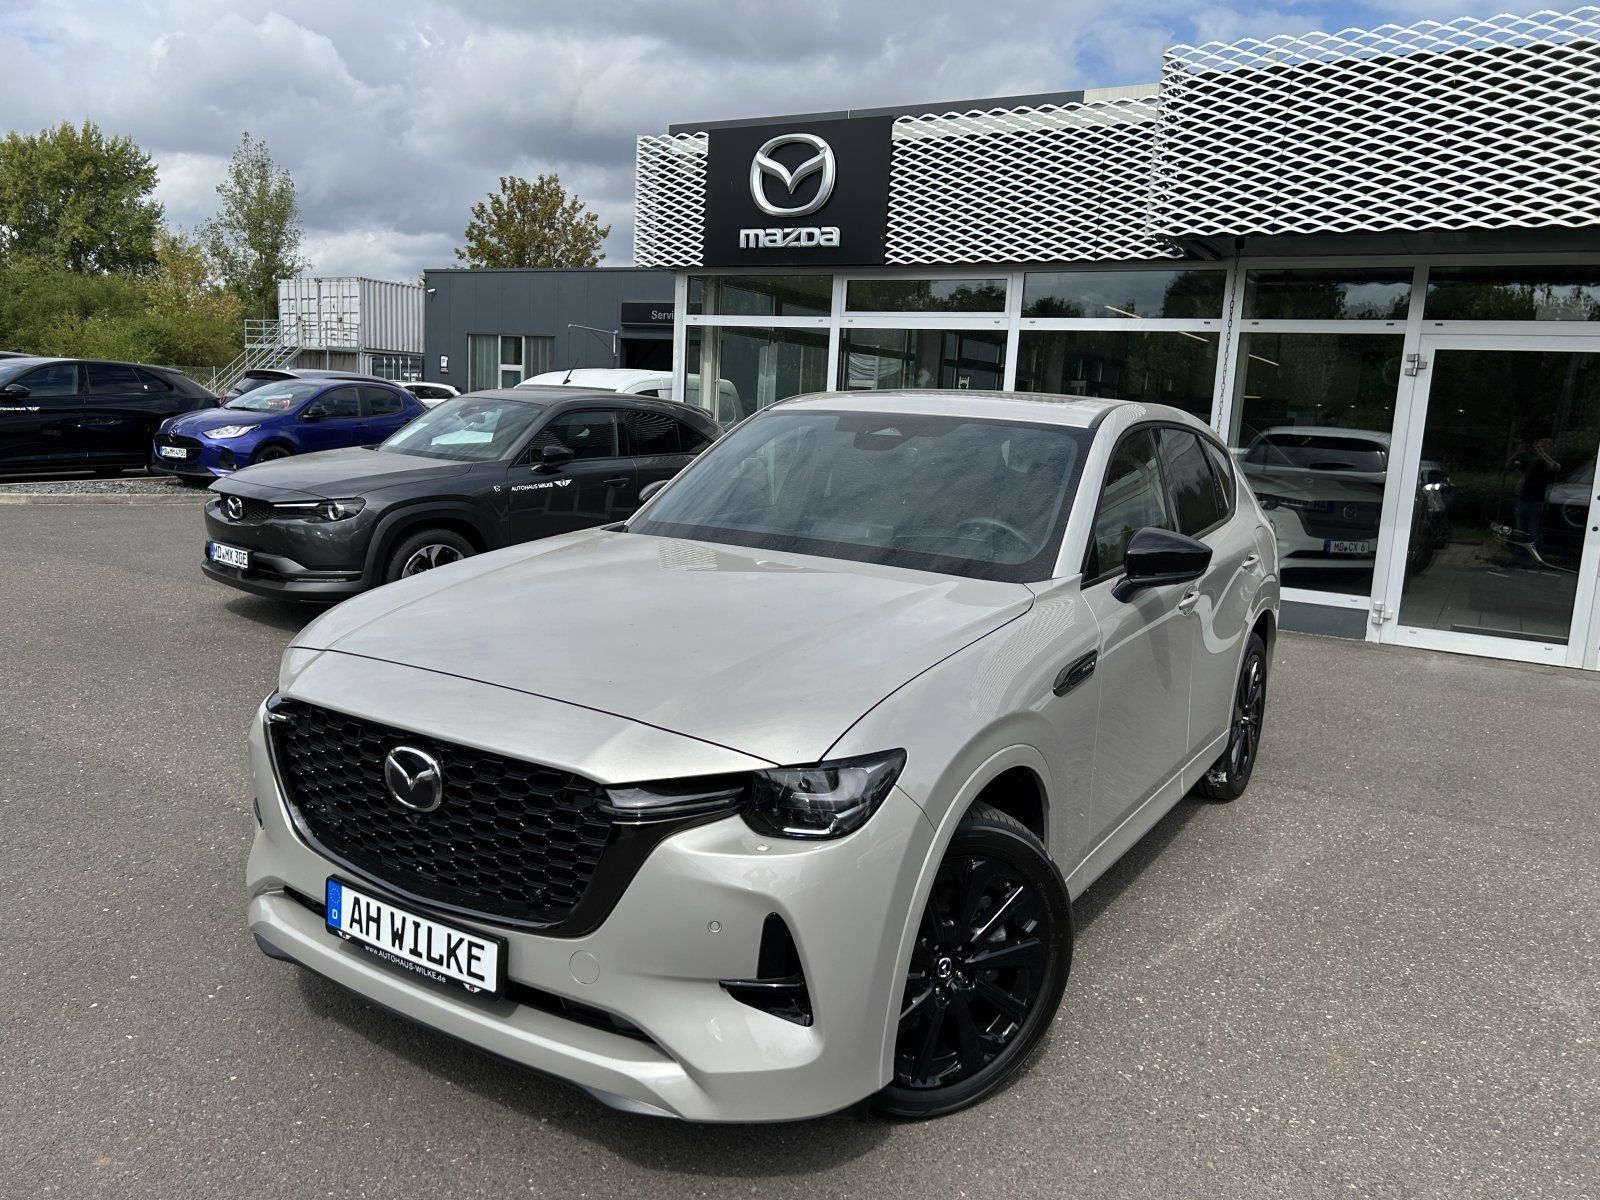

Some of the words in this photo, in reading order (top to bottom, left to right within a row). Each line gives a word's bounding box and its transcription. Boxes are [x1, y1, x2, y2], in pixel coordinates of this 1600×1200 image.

[740, 227, 840, 248] mazda
[332, 909, 338, 919] D
[350, 895, 382, 942] AH
[389, 911, 485, 983] WILKE
[364, 944, 446, 983] www.AUTOHAUS-WILKE.de
